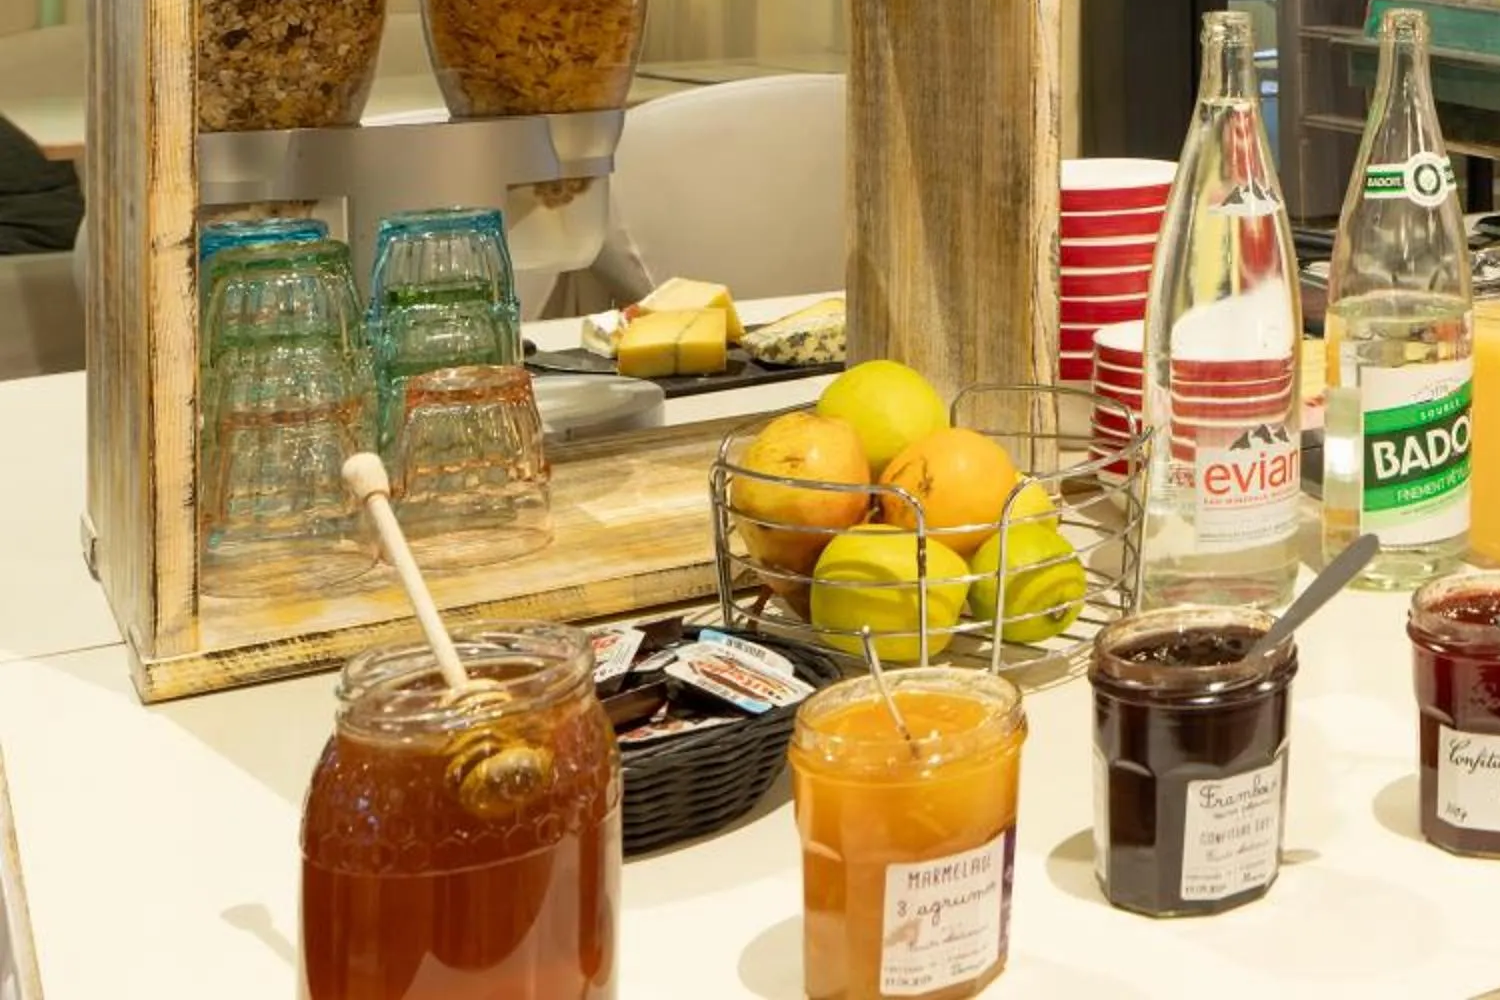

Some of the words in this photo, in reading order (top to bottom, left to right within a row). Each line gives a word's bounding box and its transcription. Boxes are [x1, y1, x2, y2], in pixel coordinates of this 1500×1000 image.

[1420, 398, 1461, 421] SOURCE
[1372, 407, 1472, 480] BADO
[1204, 450, 1299, 495] evian
[897, 900, 907, 918] 3
